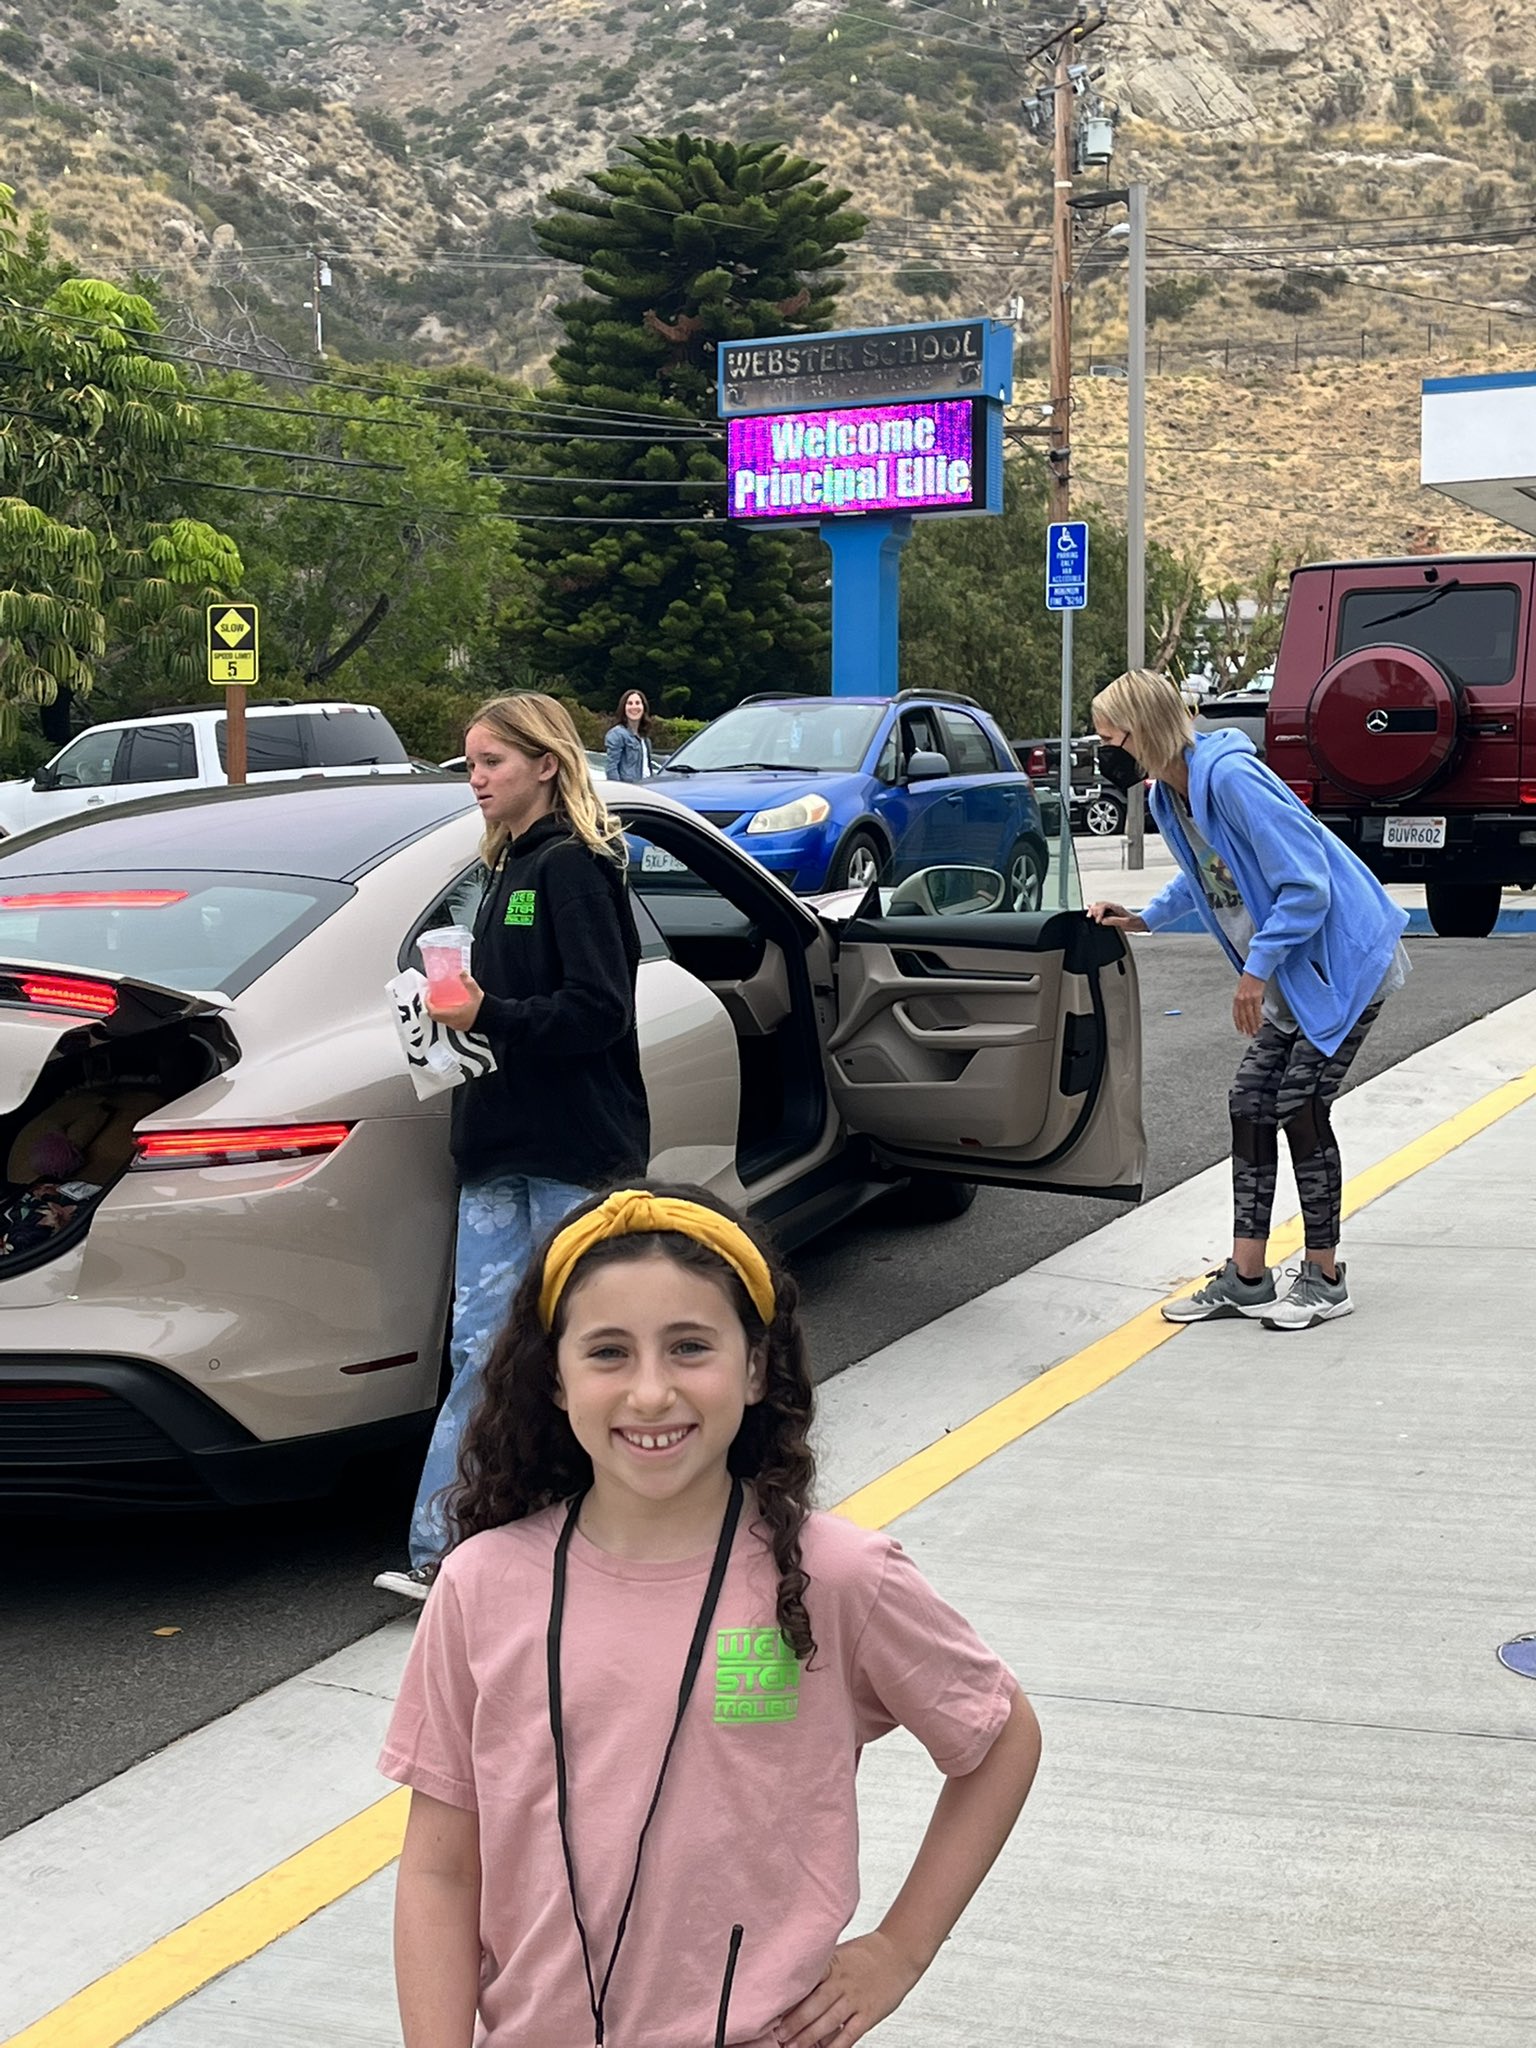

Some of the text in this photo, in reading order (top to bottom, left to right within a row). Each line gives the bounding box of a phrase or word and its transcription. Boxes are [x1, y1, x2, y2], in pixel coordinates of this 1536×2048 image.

[727, 330, 978, 379] WEBSTER SCHOOL
[771, 415, 937, 463] Welcome
[734, 455, 971, 511] Principal Ellie
[220, 623, 245, 633] SLOW
[213, 652, 251, 660] SPEED LIMIT
[227, 661, 238, 677] 5
[1387, 827, 1441, 844] 8UVR602
[645, 854, 684, 868] 5XLF
[715, 1665, 799, 1692] STER
[714, 1699, 799, 1717] MALIBU
